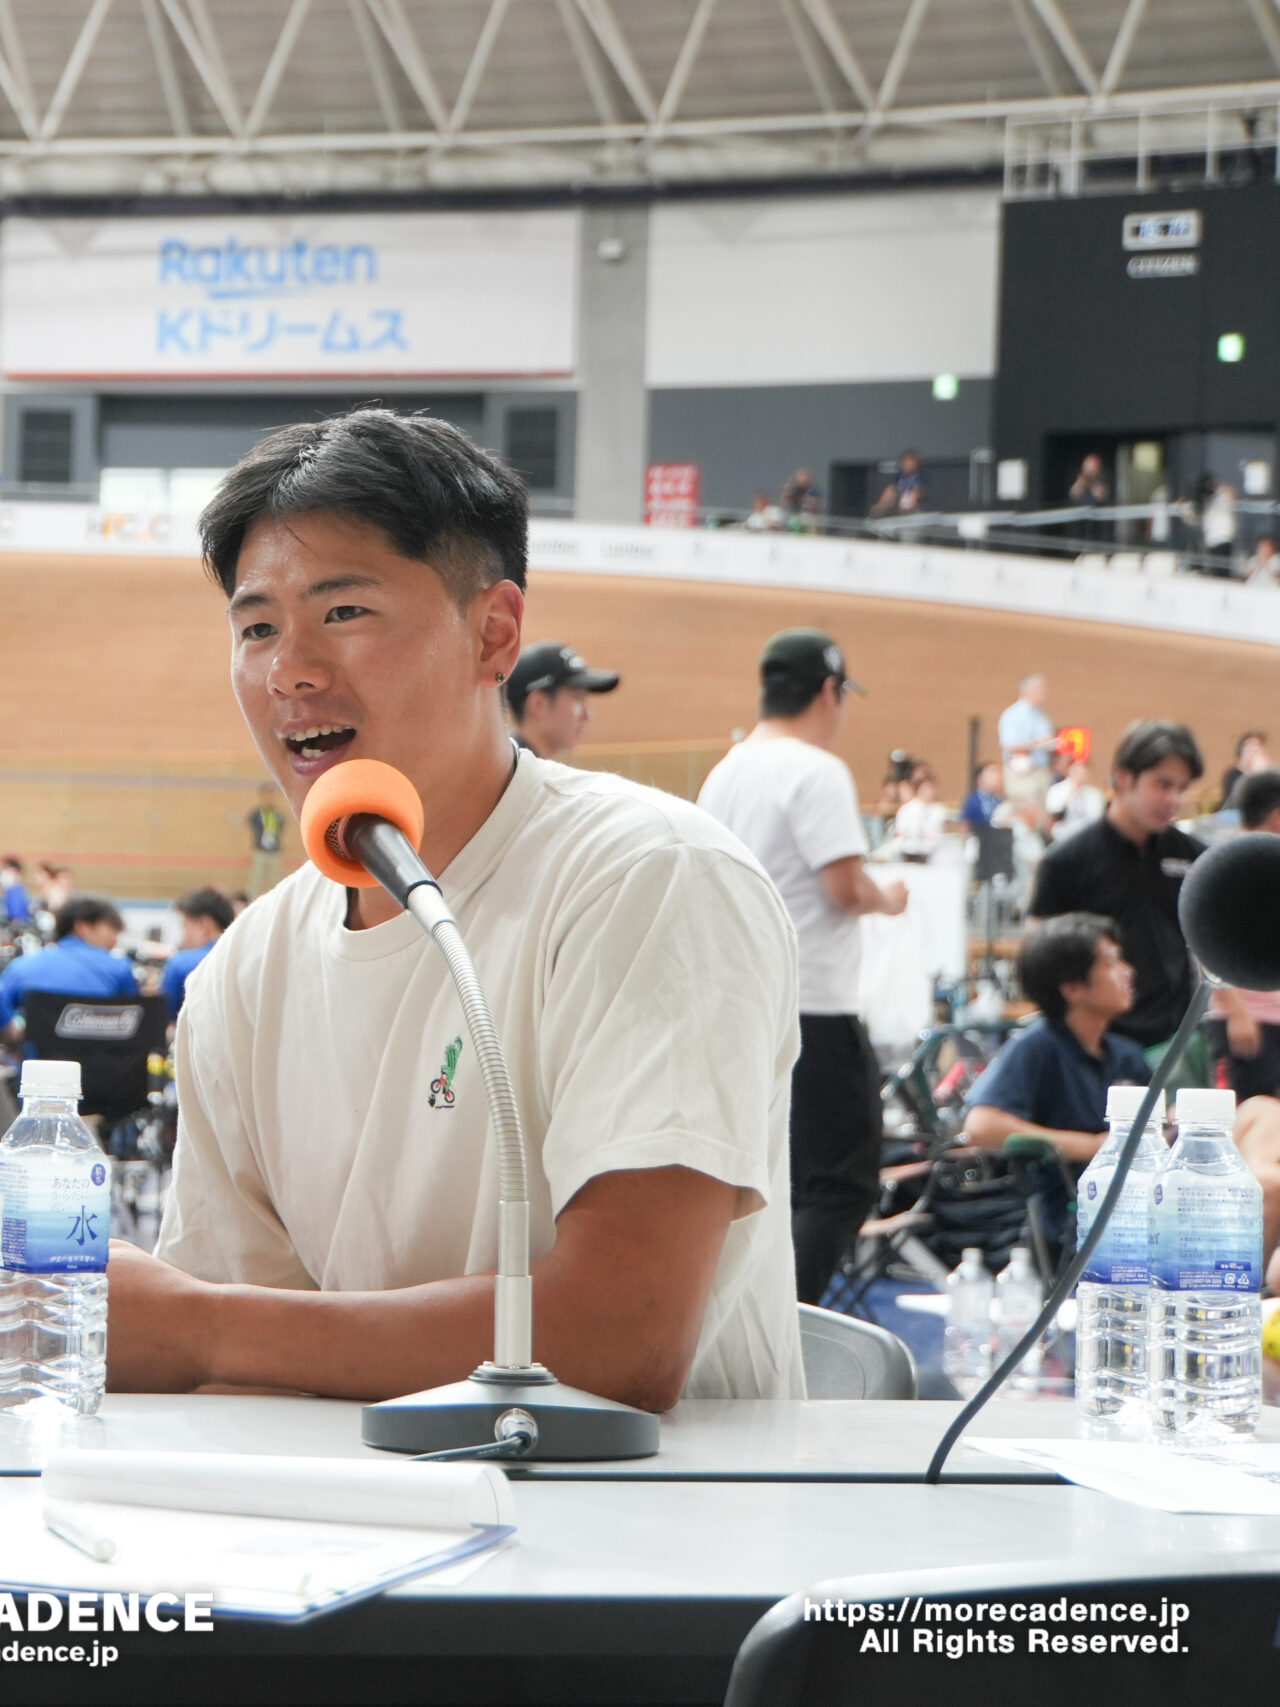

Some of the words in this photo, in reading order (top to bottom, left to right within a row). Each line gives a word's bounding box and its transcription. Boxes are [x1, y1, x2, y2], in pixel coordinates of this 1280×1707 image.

[158, 237, 378, 288] Rakuten
[156, 308, 407, 354] Kドリームス
[52, 1177, 90, 1189] あなたの
[65, 1205, 98, 1247] 水
